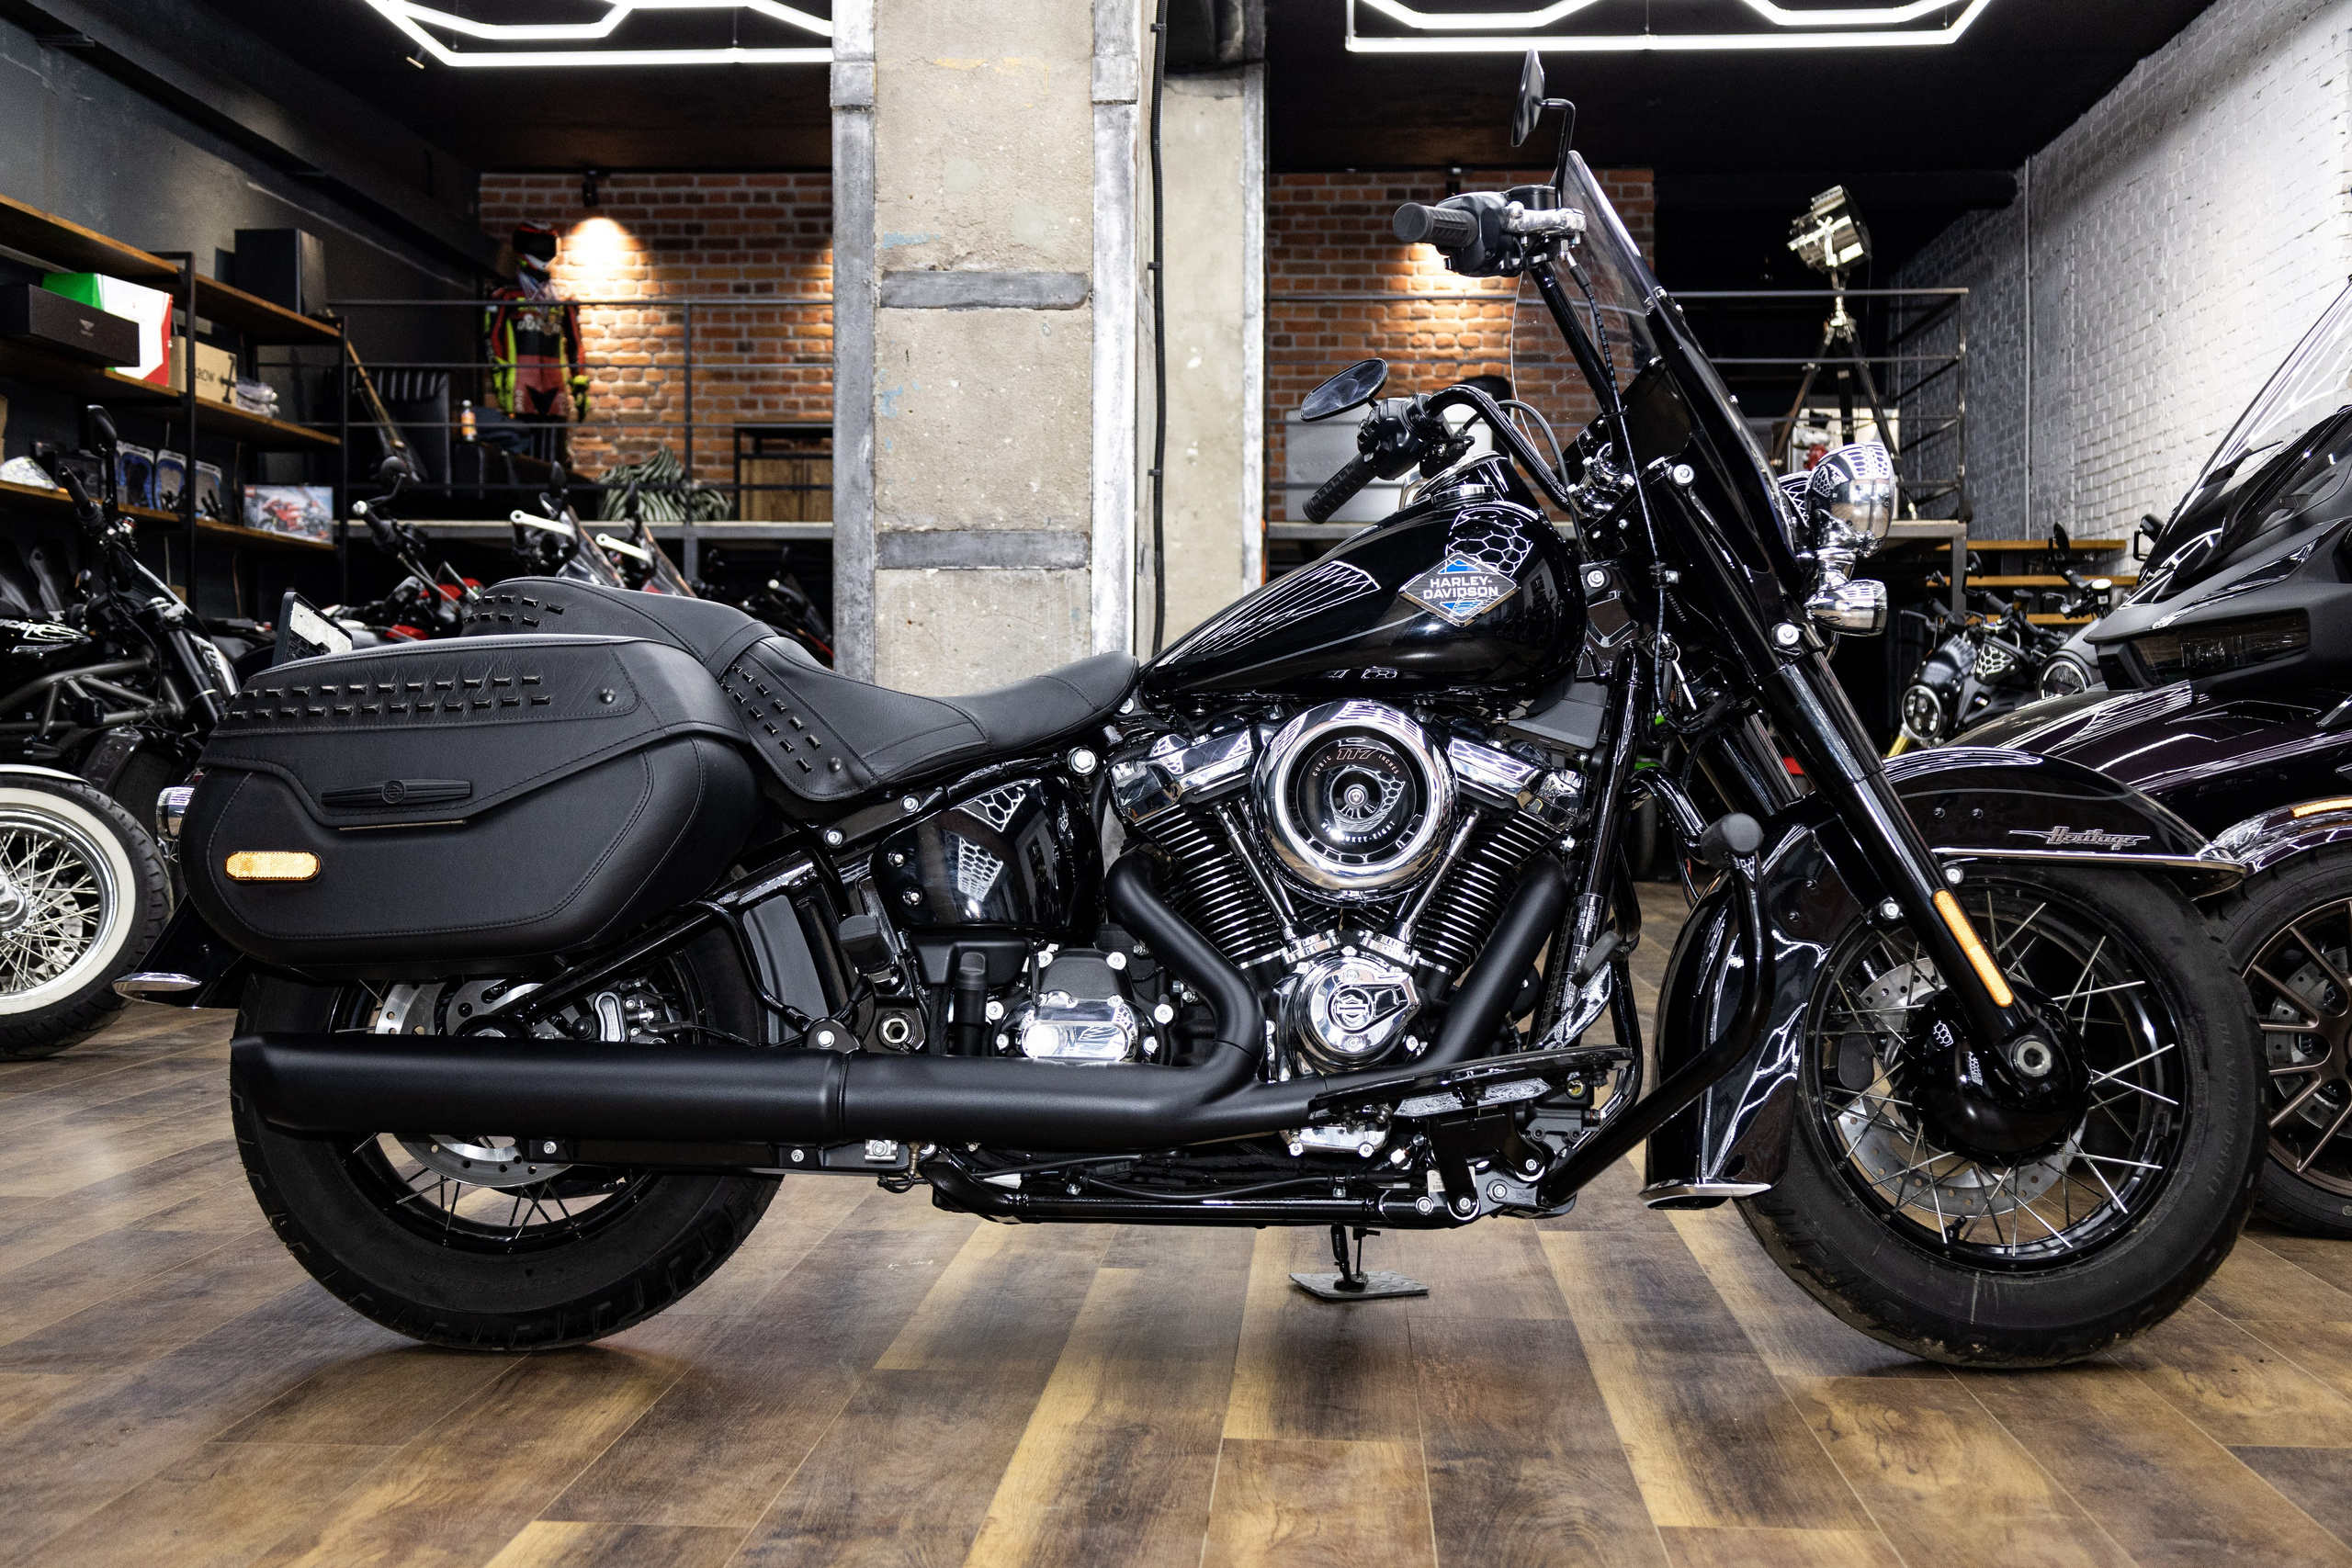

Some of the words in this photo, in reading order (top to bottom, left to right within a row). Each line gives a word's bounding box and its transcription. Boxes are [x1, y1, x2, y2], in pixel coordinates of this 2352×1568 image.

[1422, 586, 1498, 600] DAVIDSON
[1430, 575, 1493, 589] HARLEY-
[1312, 755, 1332, 777] CUBIC
[1336, 747, 1379, 761] 117
[1378, 753, 1399, 774] INCHES
[1320, 819, 1396, 842] MIUKEE-EIGHT
[2045, 826, 2139, 850] Heritage
